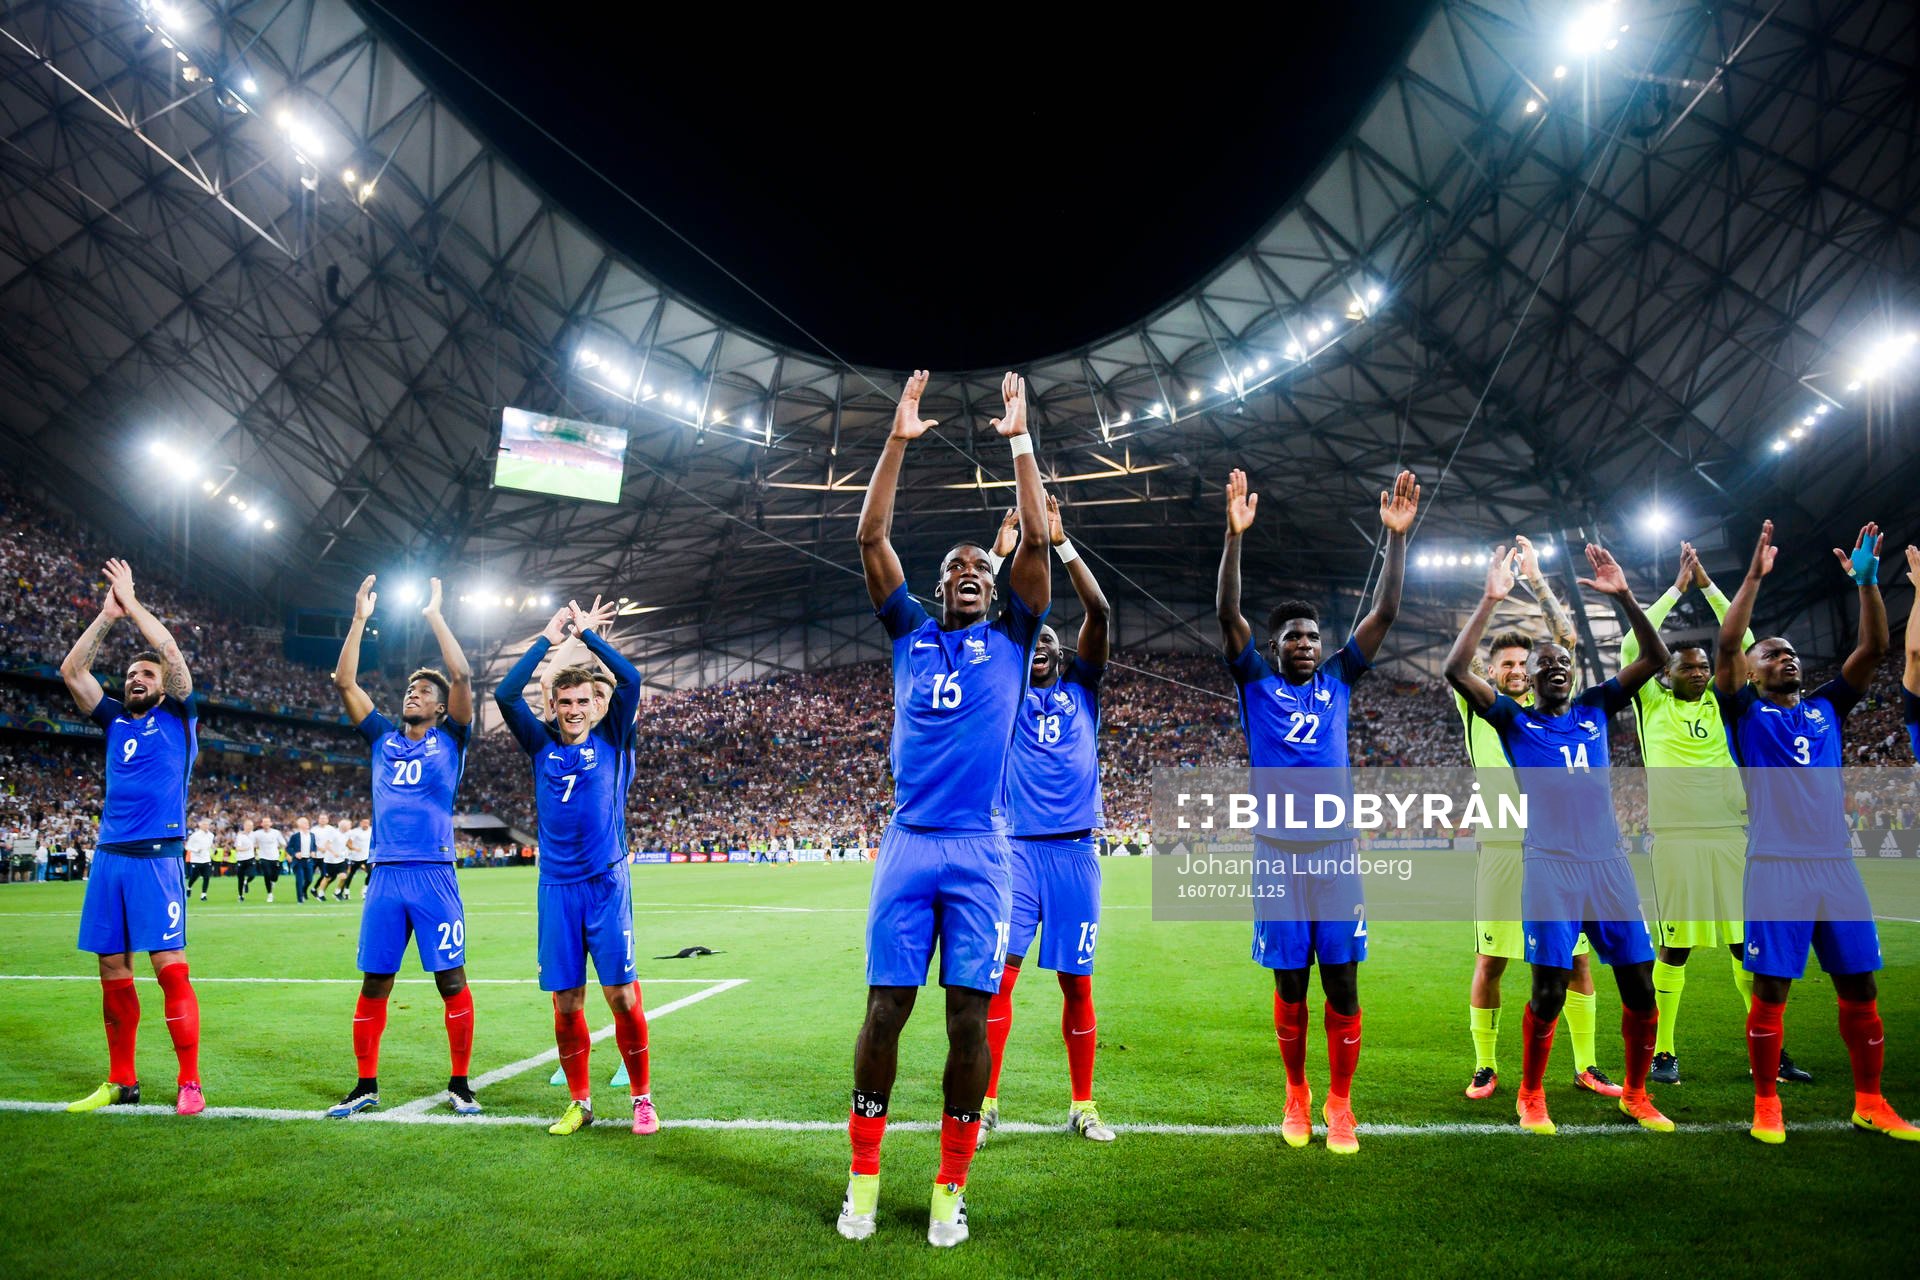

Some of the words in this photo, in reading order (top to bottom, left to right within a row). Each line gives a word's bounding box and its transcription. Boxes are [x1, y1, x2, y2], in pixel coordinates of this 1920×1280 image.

[931, 670, 963, 710] 15
[1036, 714, 1061, 744] 13
[1283, 712, 1320, 744] 22
[1683, 718, 1709, 739] 16
[123, 738, 138, 763] 9
[1559, 743, 1591, 775] 14
[1793, 735, 1811, 766] 3
[392, 759, 422, 786] 20
[561, 774, 577, 803] 7
[167, 901, 181, 928] 9
[437, 919, 465, 951] 20
[1078, 922, 1098, 953] 13
